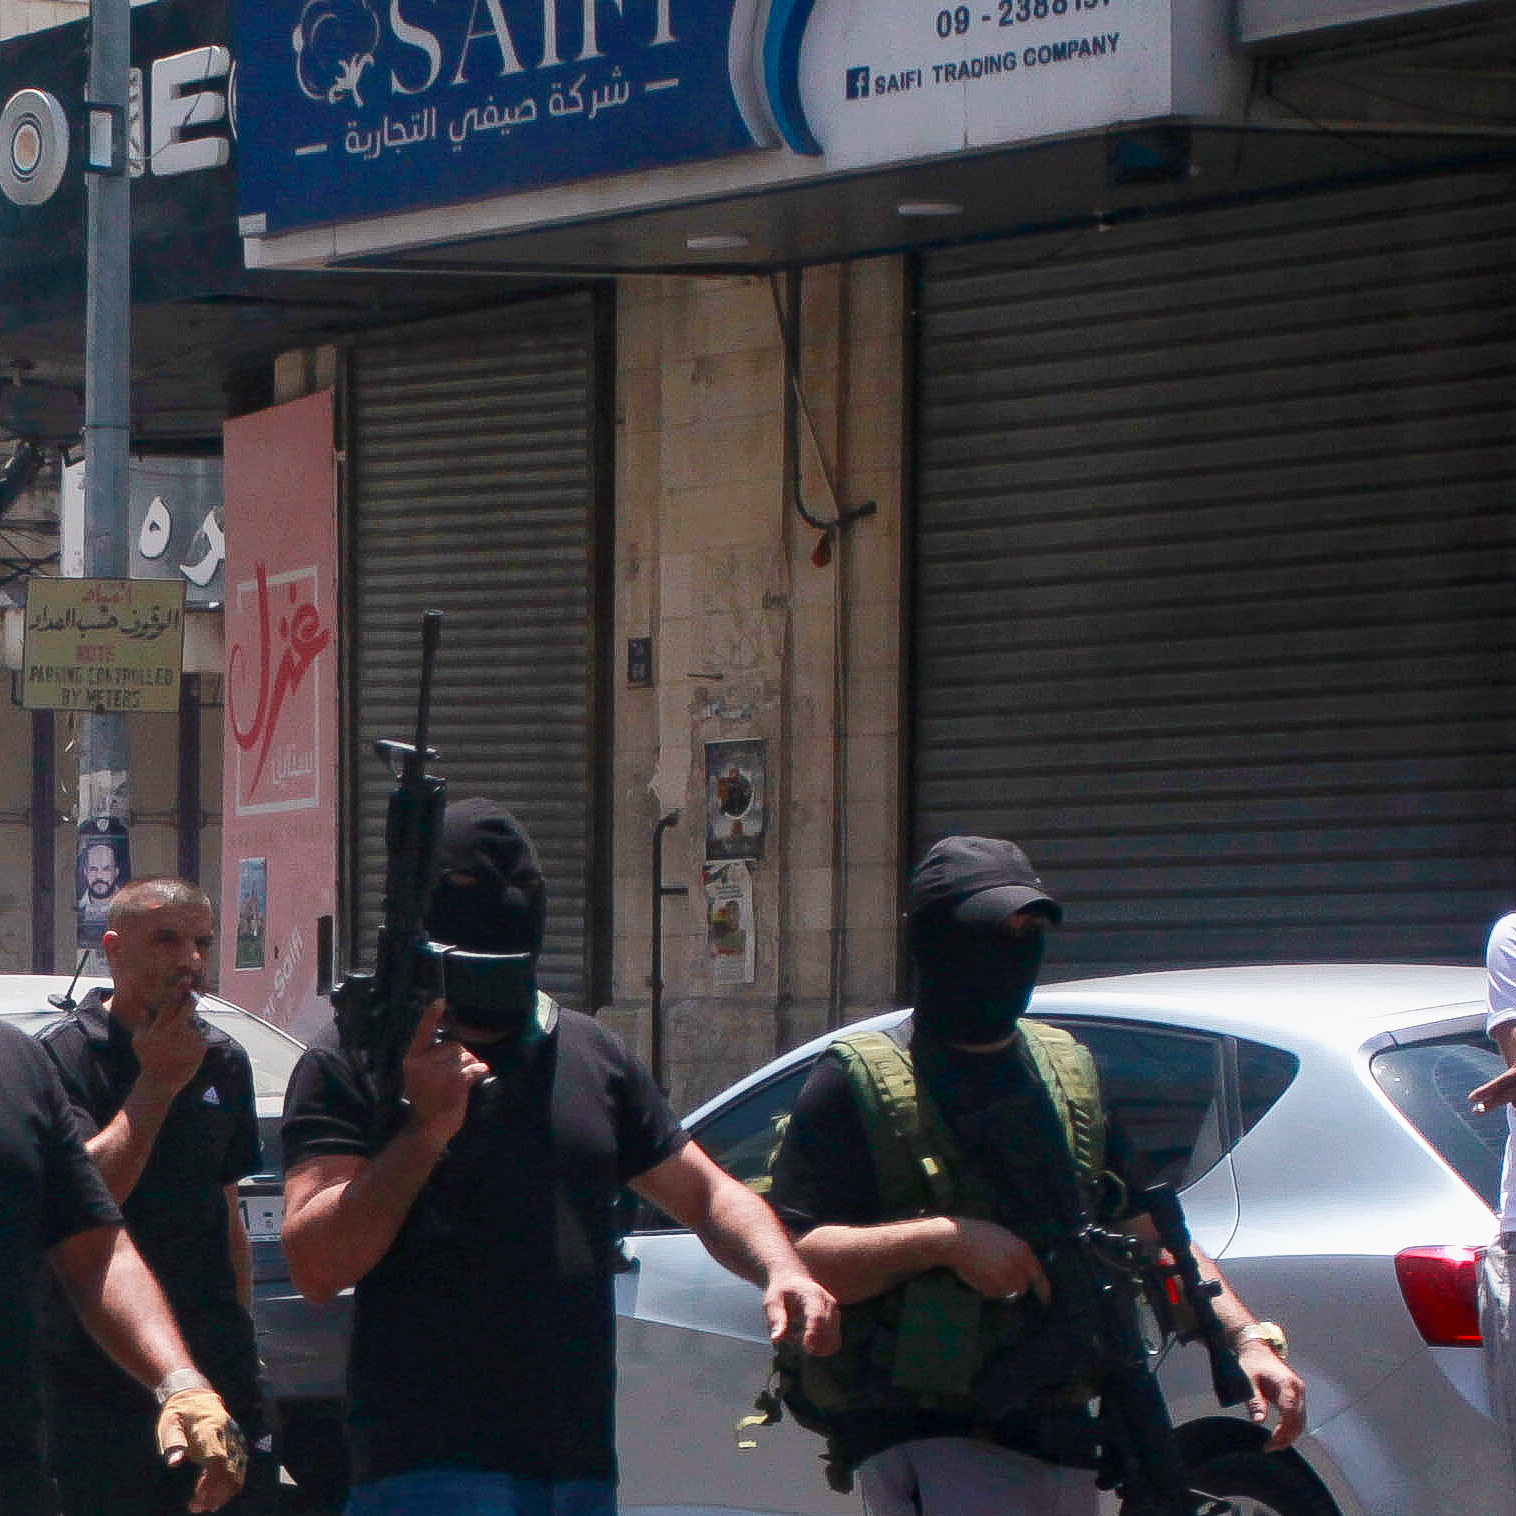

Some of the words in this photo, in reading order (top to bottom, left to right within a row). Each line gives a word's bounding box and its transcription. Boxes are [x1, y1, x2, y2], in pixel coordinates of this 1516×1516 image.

[936, 5, 970, 38] 09
[874, 68, 922, 95] SAIFI
[932, 51, 1018, 84] TRADING
[1022, 31, 1120, 67] COMPANY
[548, 64, 630, 122] شركة
[344, 106, 437, 161] التجارية
[449, 95, 538, 153] صيفي
